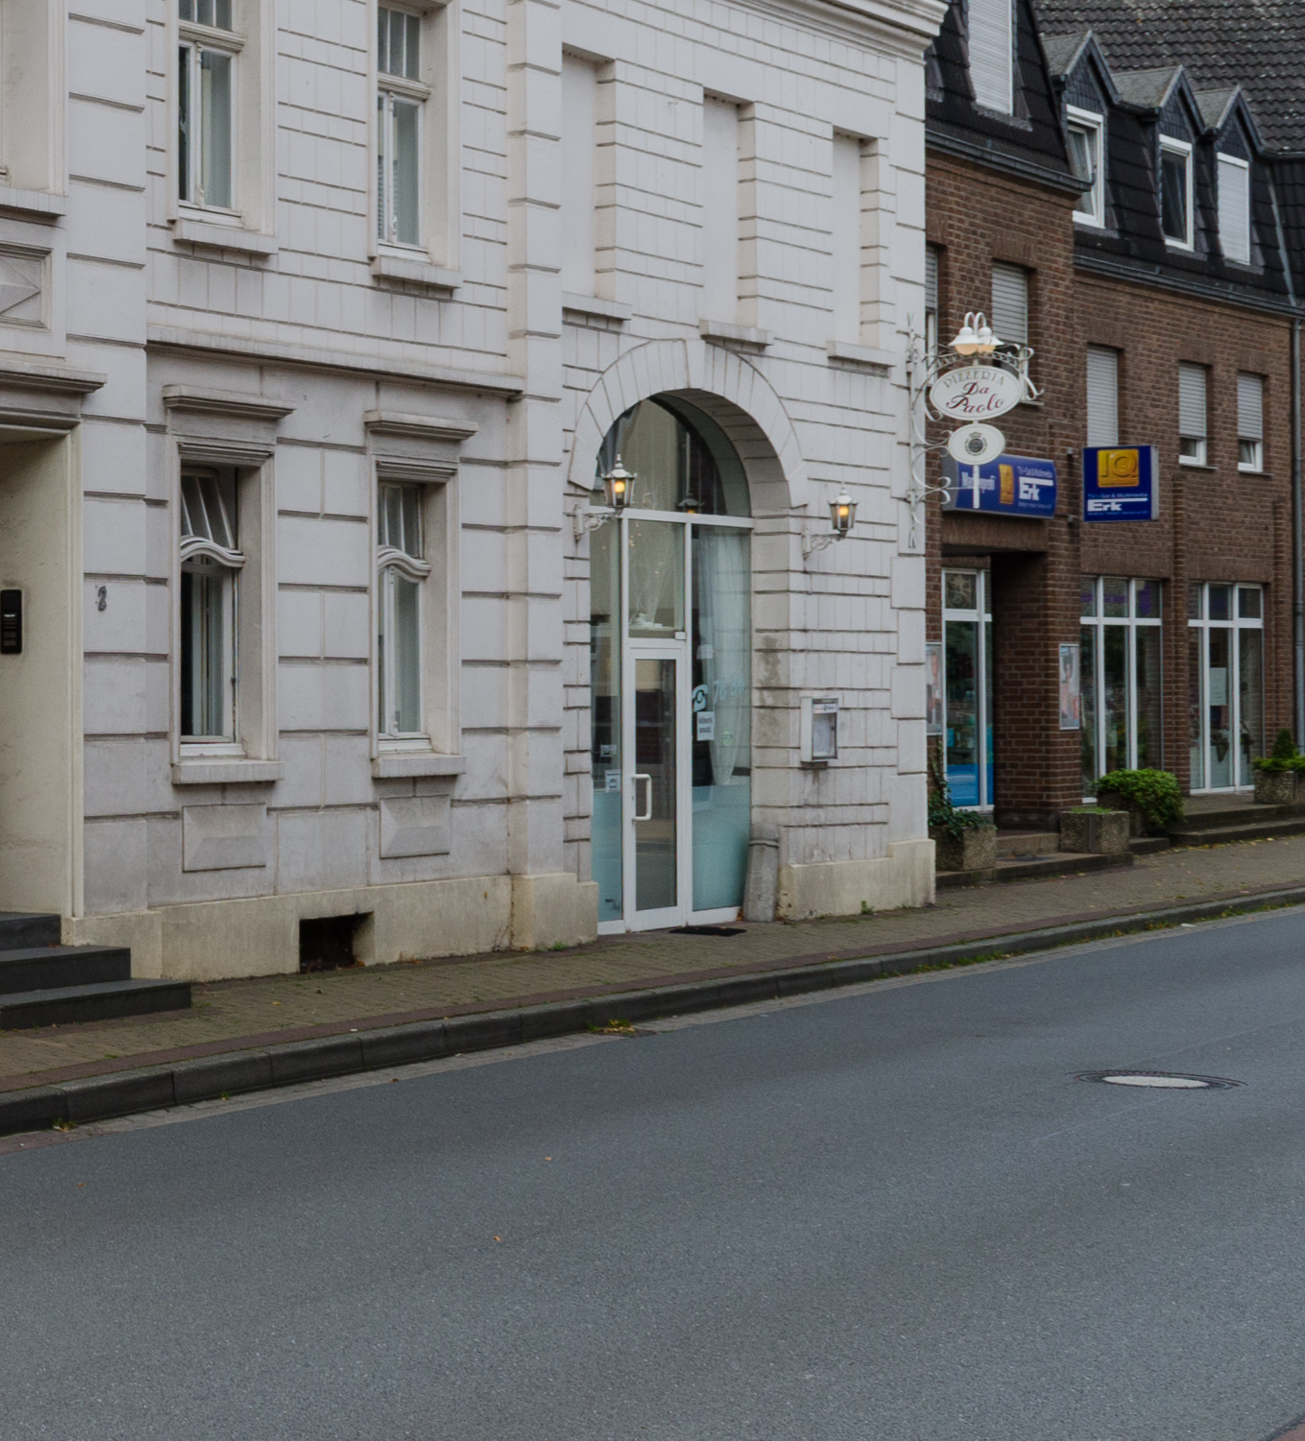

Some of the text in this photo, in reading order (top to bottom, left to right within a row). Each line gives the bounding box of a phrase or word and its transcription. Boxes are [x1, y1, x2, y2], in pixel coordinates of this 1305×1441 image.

[943, 370, 1005, 389] PIZZERIA
[962, 381, 990, 396] Da
[946, 393, 1004, 414] Paolo
[1019, 476, 1041, 501] Erk
